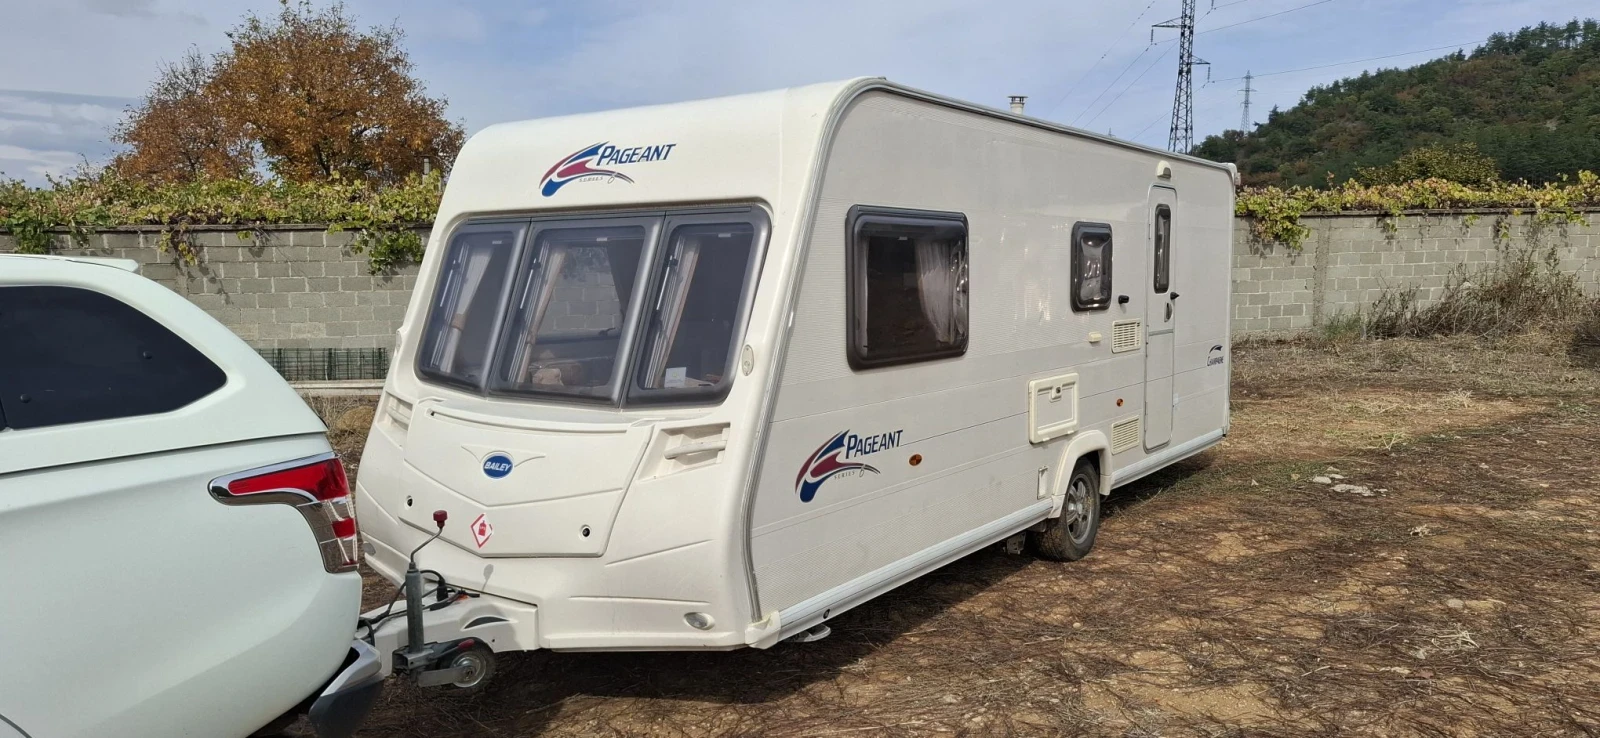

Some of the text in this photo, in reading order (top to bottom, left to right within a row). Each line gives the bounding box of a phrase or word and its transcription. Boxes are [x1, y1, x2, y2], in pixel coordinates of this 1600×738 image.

[596, 143, 676, 166] PAGEANT
[845, 429, 903, 459] PAGEANT
[484, 461, 512, 471] BAILEY
[834, 470, 855, 480] SERIES
